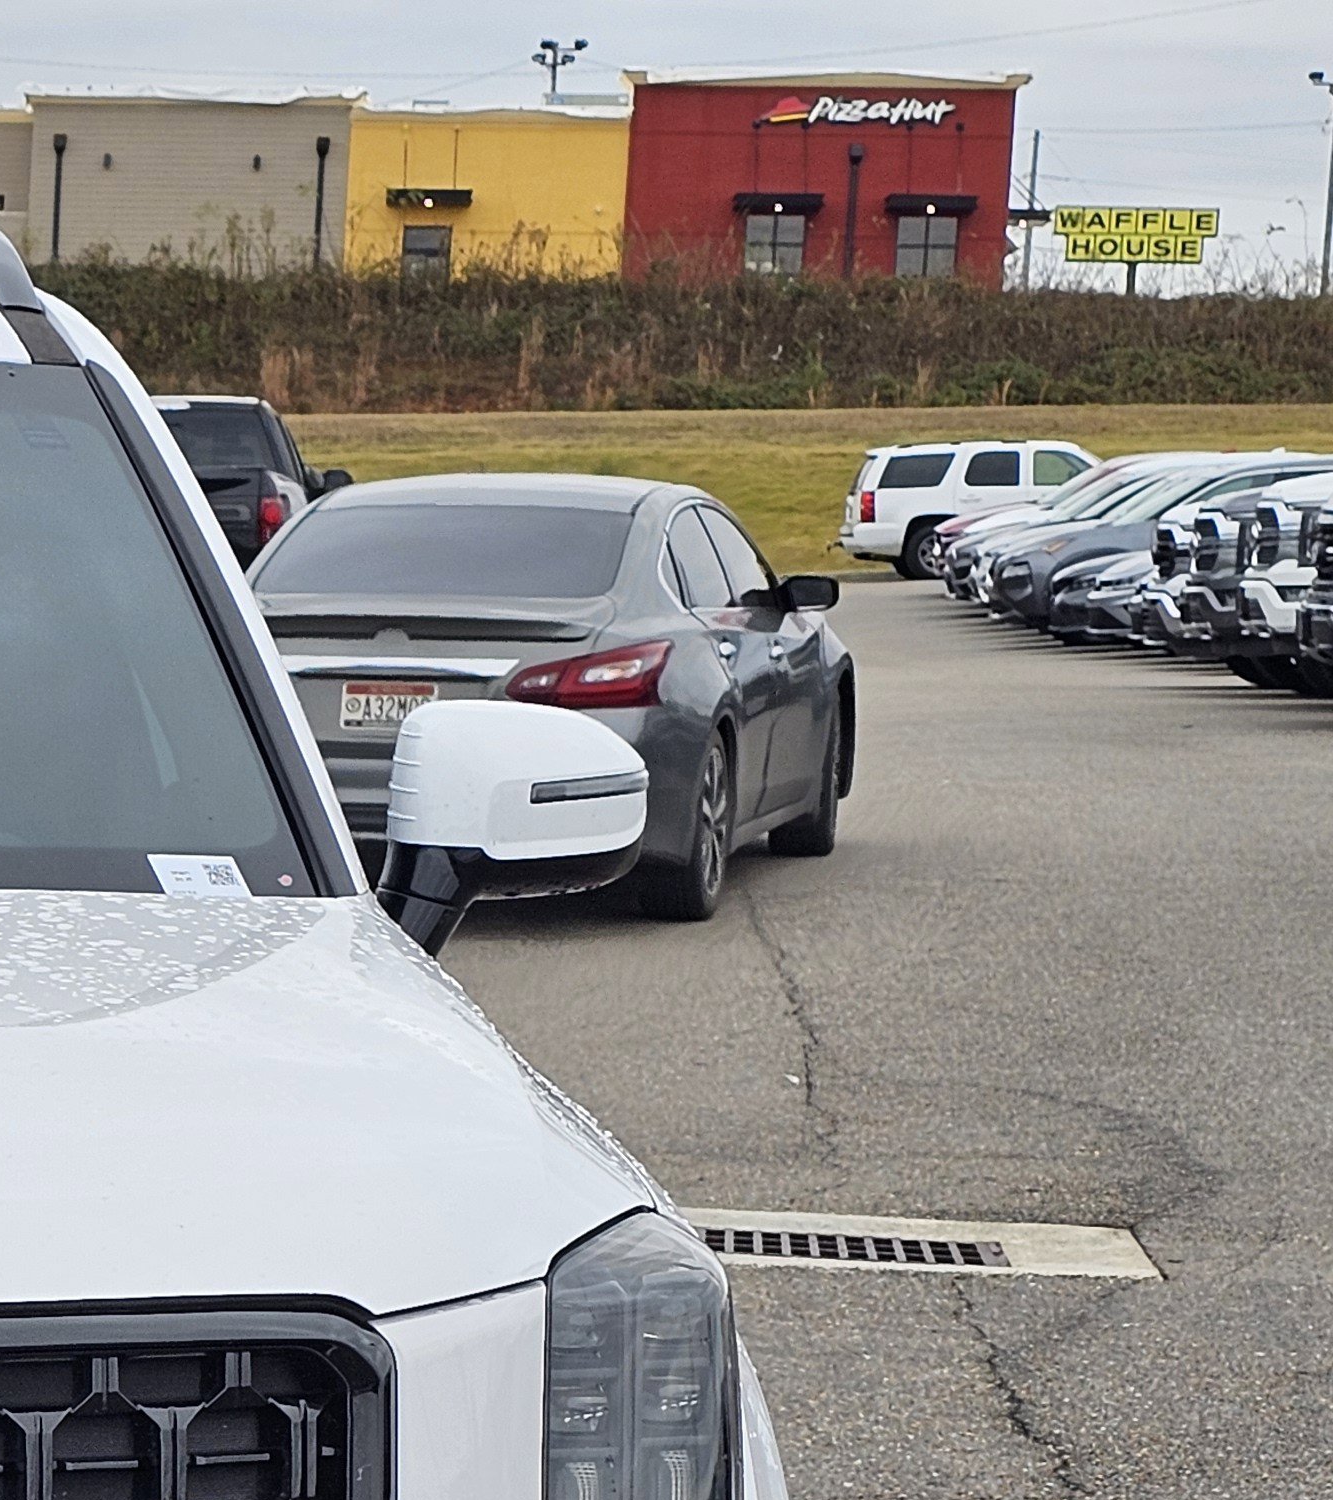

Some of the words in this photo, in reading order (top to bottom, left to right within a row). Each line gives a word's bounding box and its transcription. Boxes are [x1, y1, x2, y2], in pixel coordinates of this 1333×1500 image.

[808, 96, 889, 123] Pizza
[890, 97, 956, 125] Hut
[1059, 211, 1213, 231] WAFFLE
[1071, 238, 1198, 258] HOUSE
